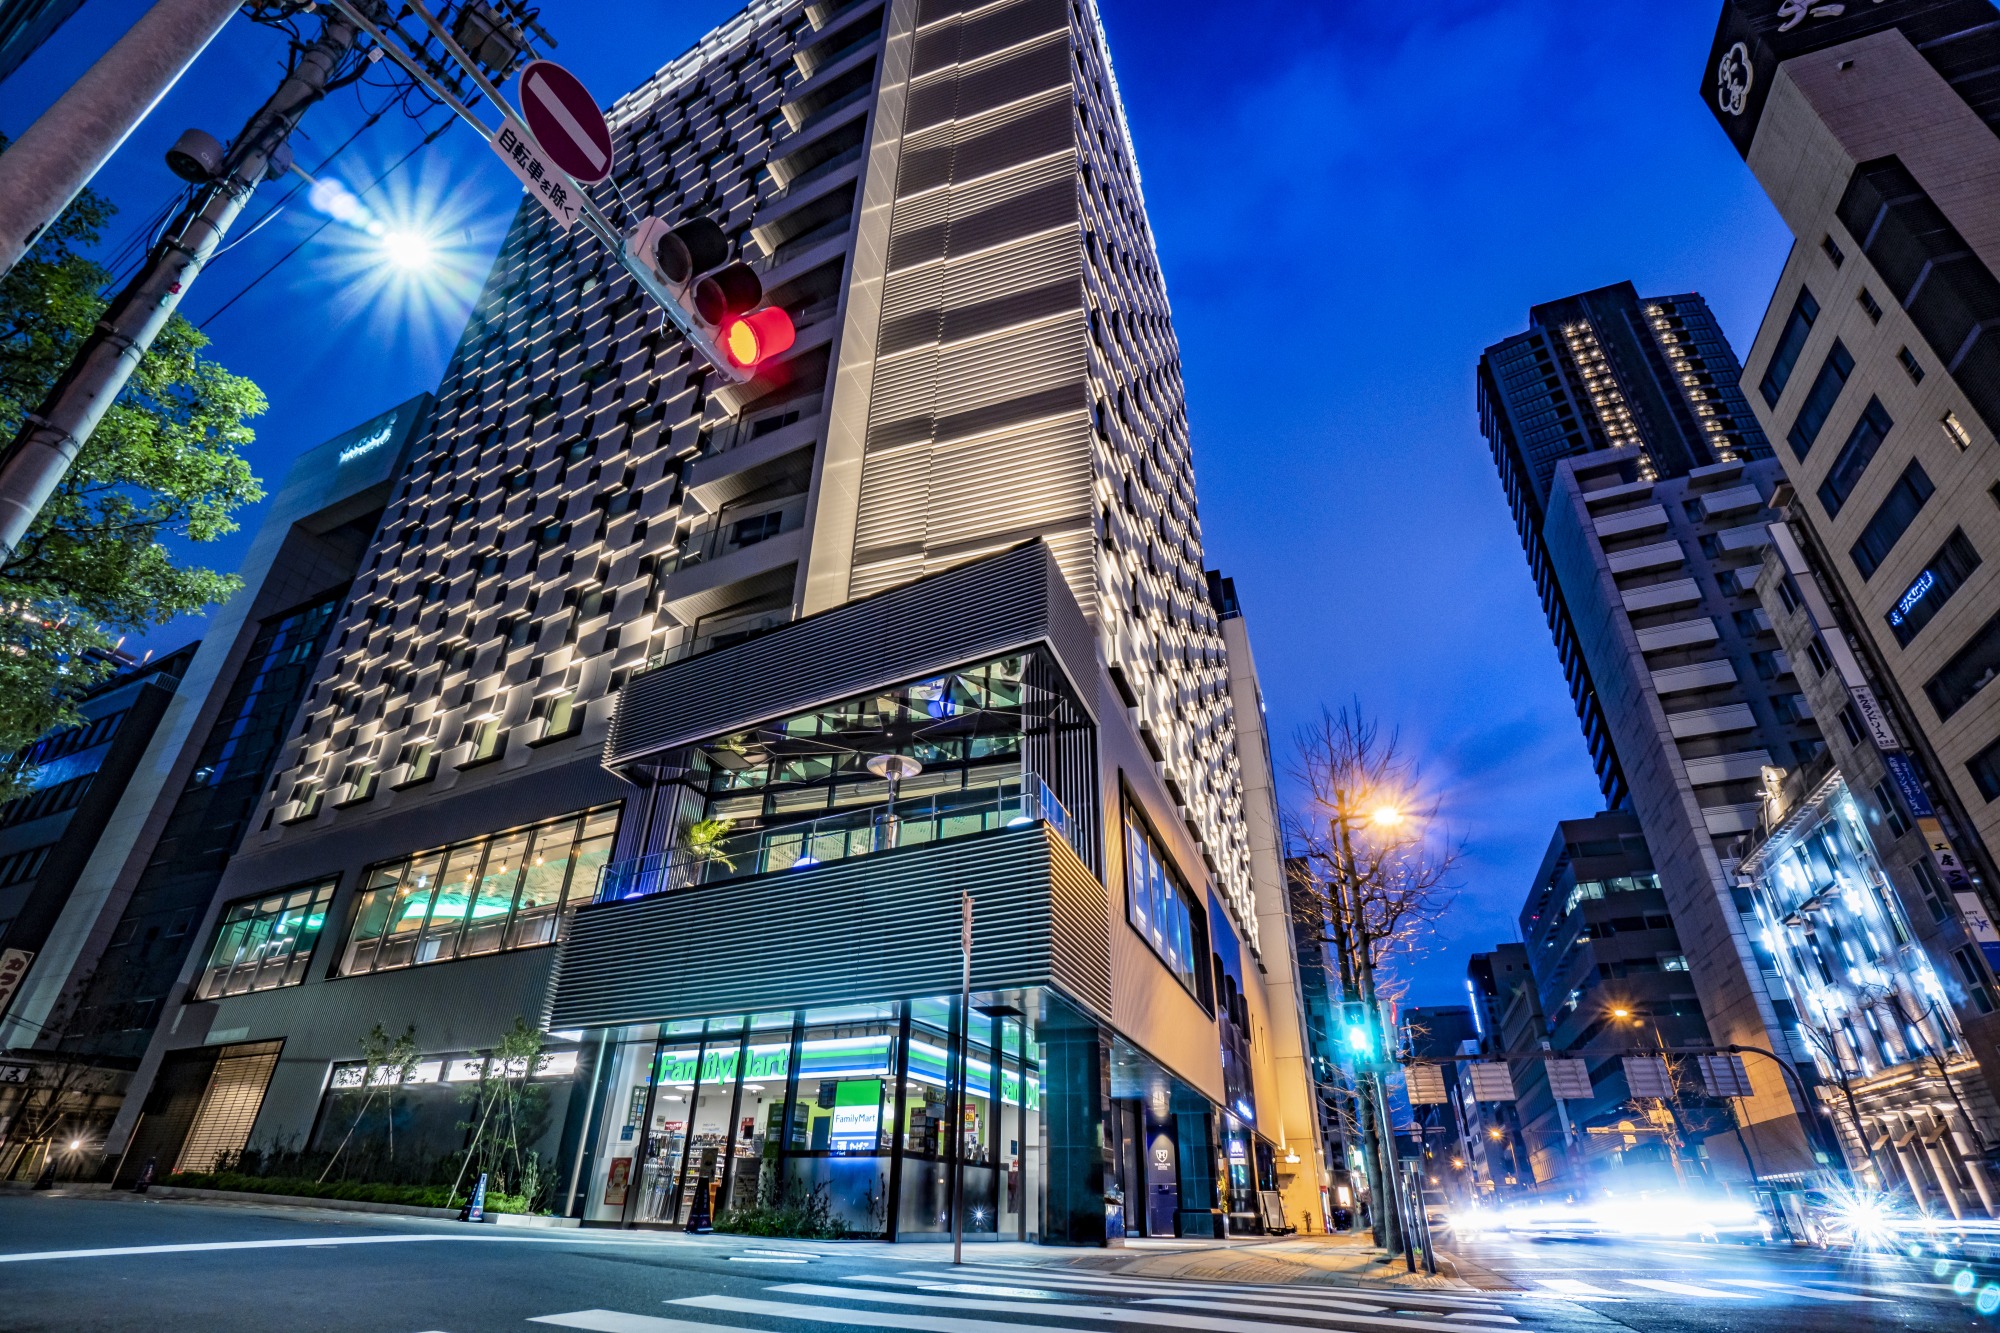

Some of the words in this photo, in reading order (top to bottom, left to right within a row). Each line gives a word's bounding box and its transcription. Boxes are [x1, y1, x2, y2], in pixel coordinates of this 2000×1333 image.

[498, 127, 575, 220] 自転車を除く
[659, 1048, 788, 1085] FamilyMart
[835, 1113, 876, 1125] FamilyMart
